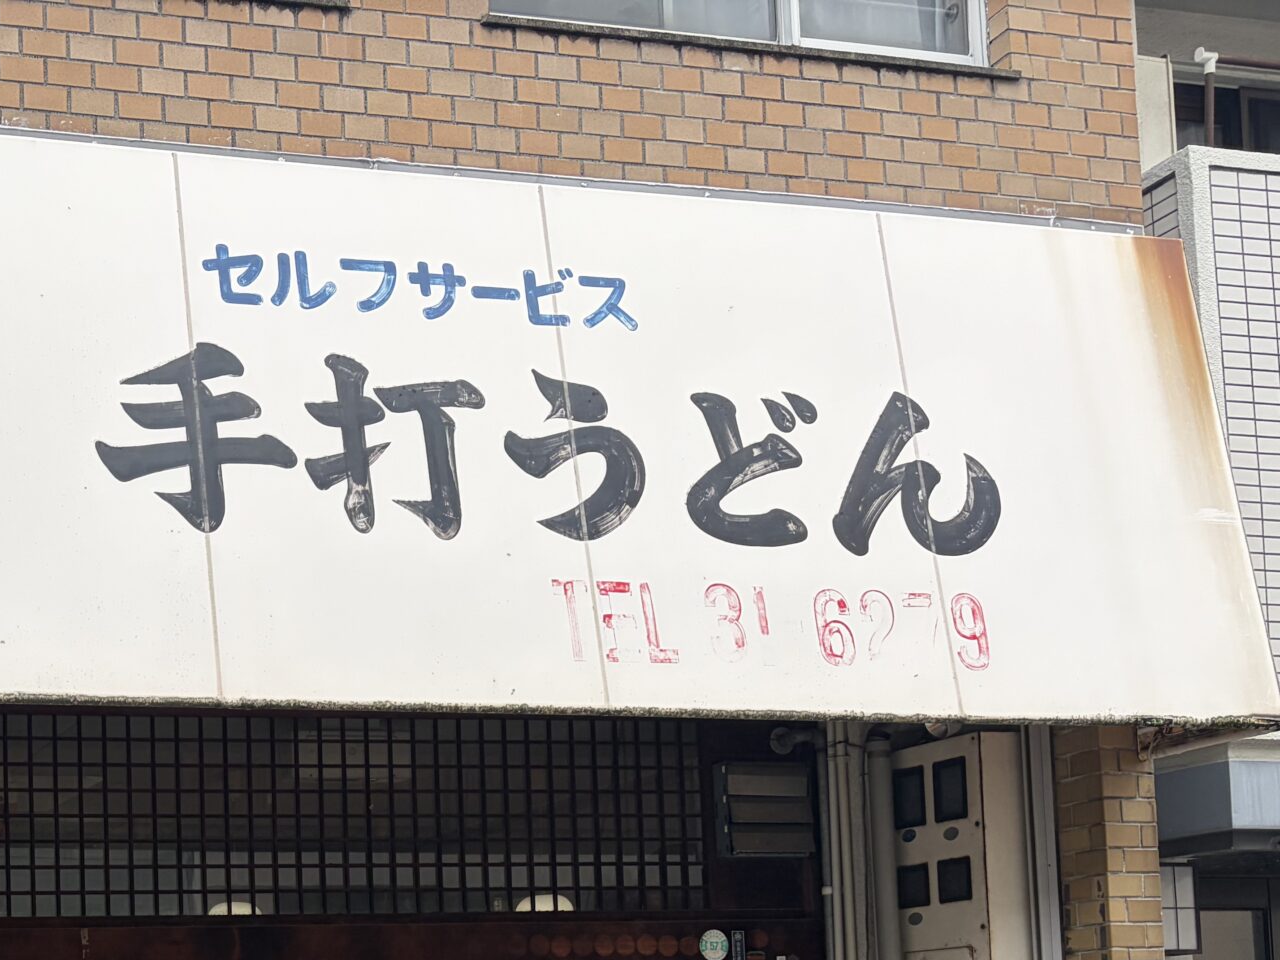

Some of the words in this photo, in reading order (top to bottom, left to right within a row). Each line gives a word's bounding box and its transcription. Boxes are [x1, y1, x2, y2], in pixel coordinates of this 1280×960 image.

[202, 243, 639, 332] セルフサービス
[94, 341, 1003, 558] 手打うどん
[551, 578, 680, 664] TEL
